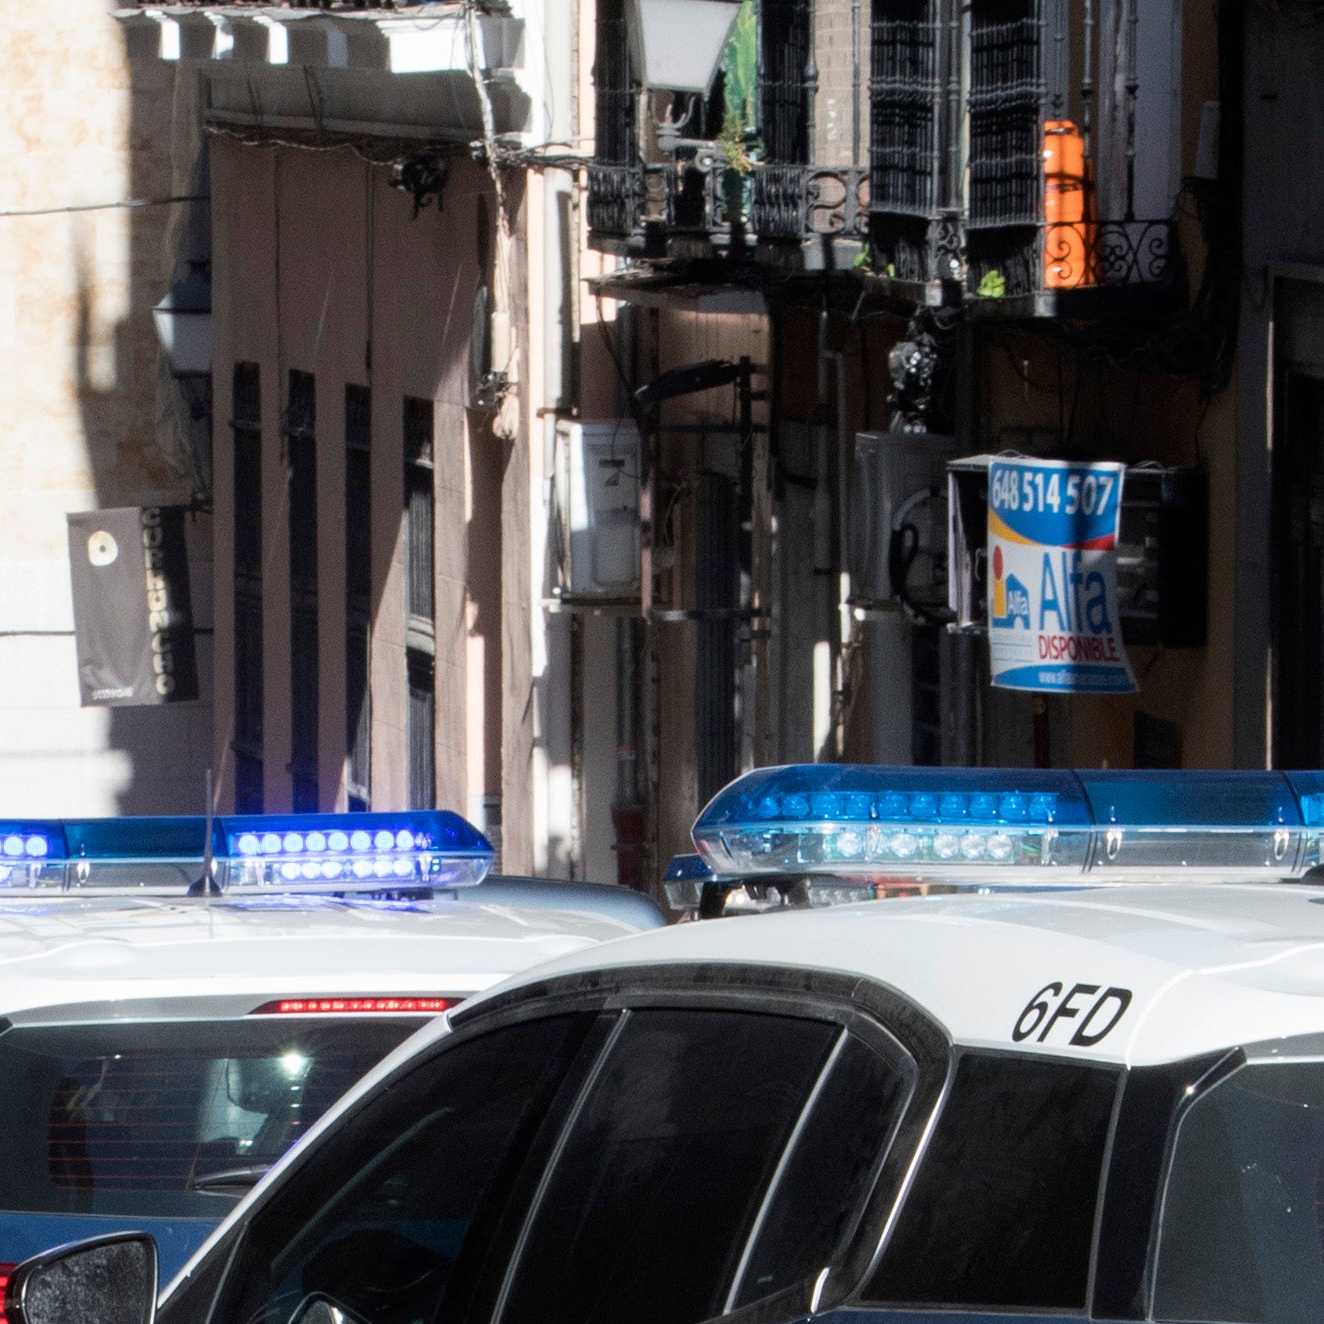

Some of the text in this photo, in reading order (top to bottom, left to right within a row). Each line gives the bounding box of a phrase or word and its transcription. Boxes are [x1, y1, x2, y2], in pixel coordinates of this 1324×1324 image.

[992, 470, 1115, 516] 648 514 507
[1039, 549, 1113, 635] Alfa
[1038, 635, 1121, 662] DISPONIBLE
[1012, 981, 1132, 1047] 6FD
